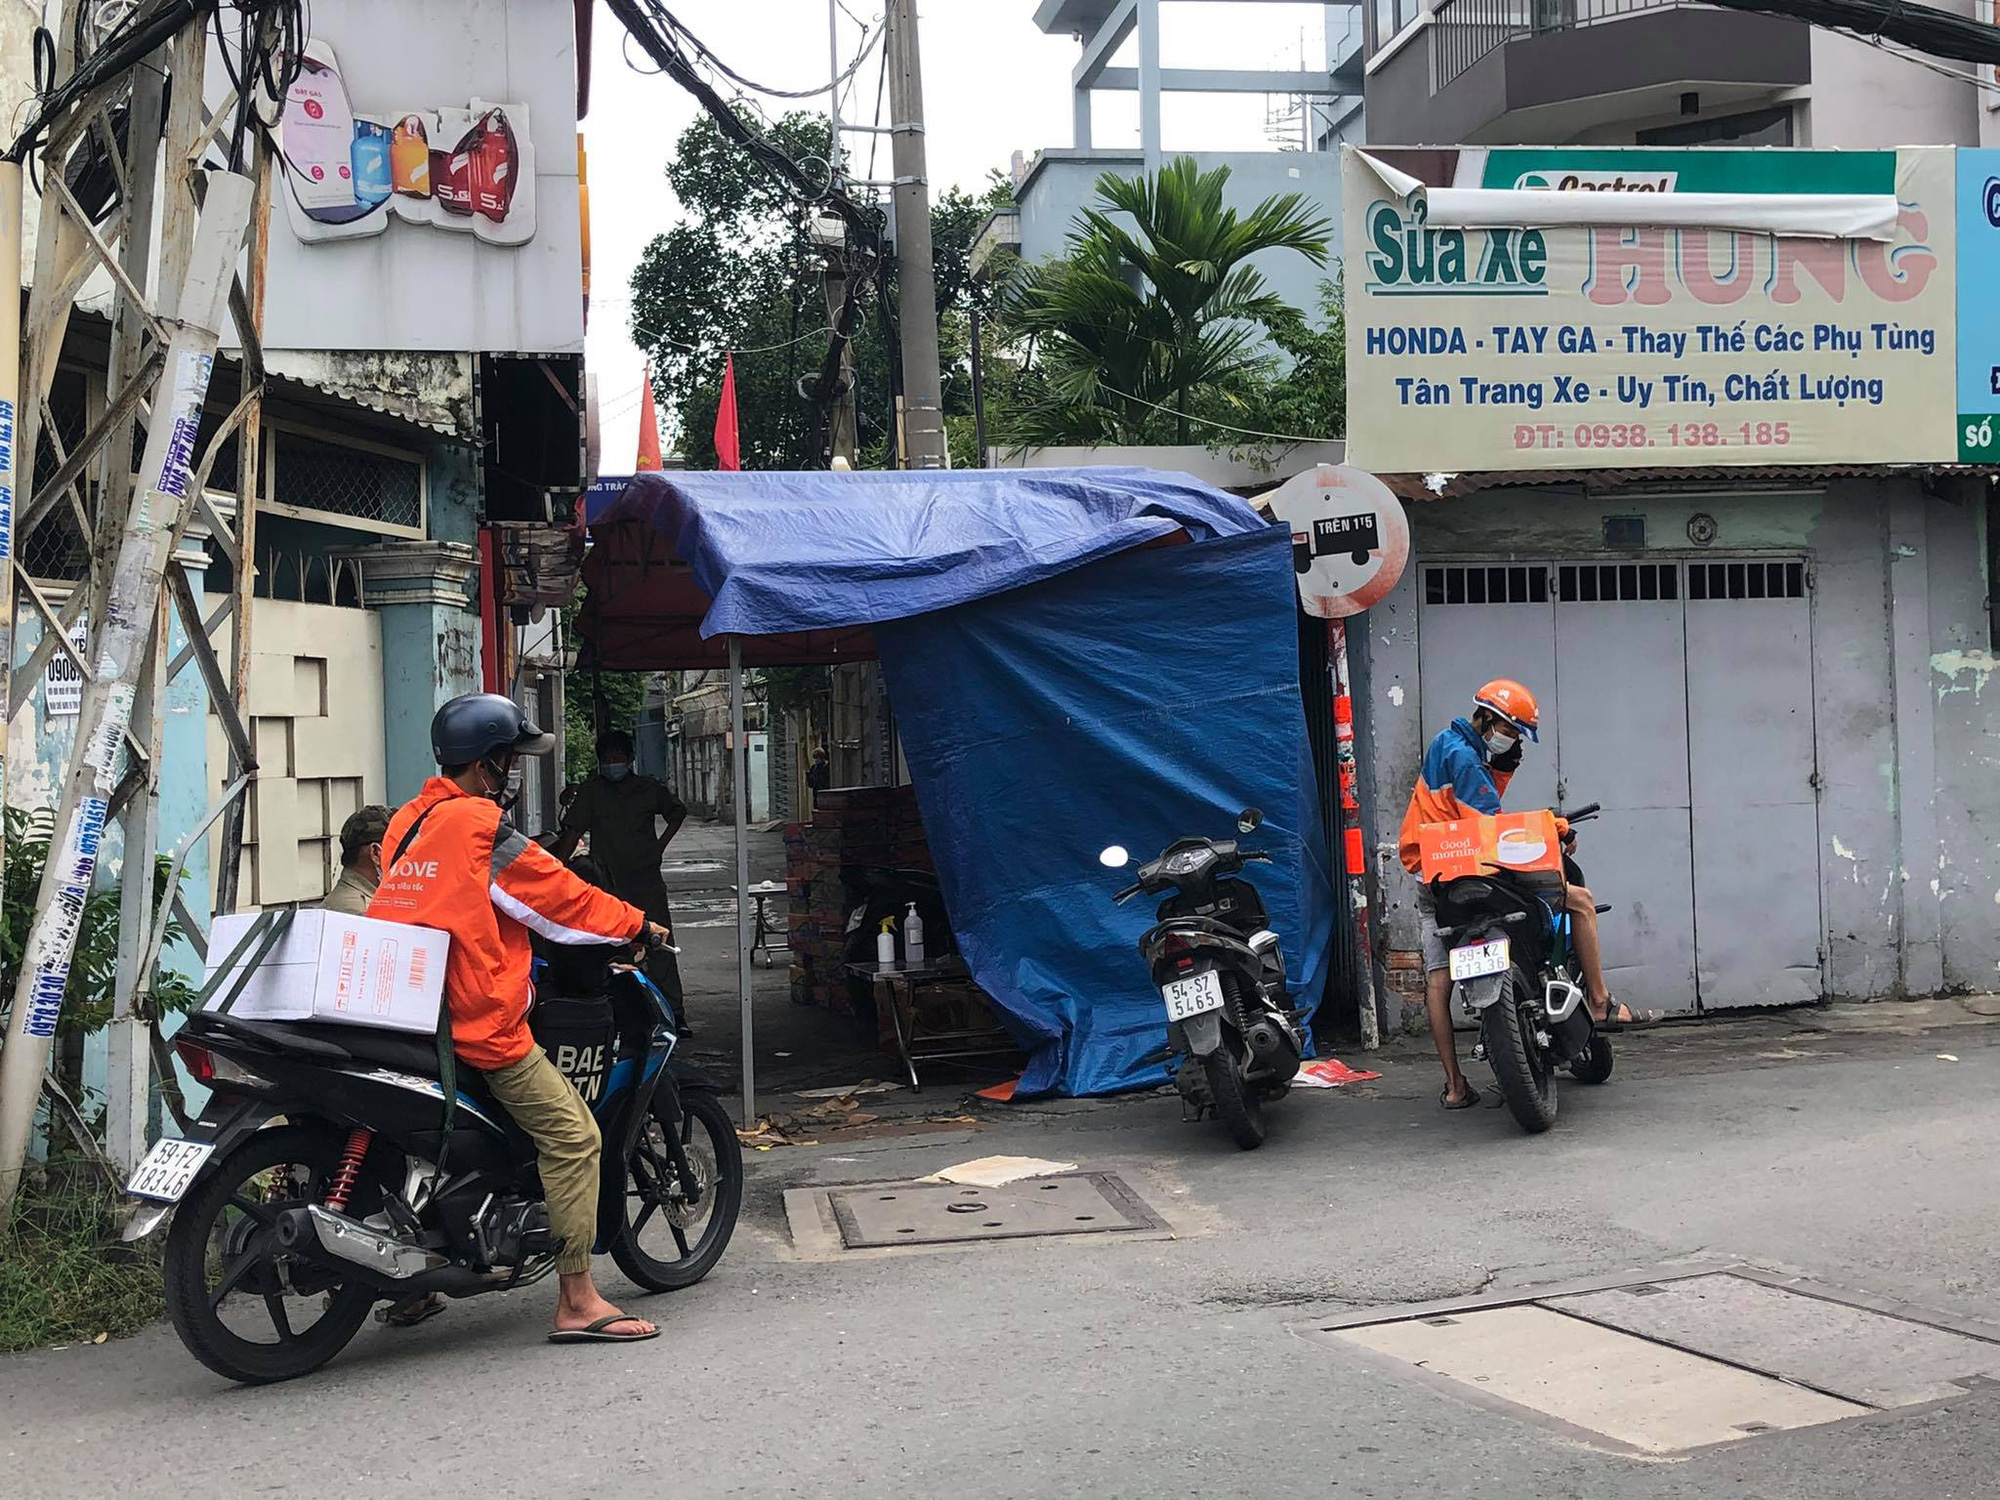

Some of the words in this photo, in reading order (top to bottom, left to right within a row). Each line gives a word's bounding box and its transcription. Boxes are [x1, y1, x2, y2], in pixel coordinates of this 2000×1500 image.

[1366, 326, 1467, 355] HONDA
[1492, 326, 1549, 354] TAY
[1557, 326, 1597, 354] GA
[1622, 324, 1687, 358] Thay
[1696, 320, 1746, 352] Thế
[1754, 324, 1804, 351] Các
[1813, 324, 1862, 358] Phụ
[1871, 322, 1935, 355] Tùng
[1395, 377, 1450, 405] Tân
[1459, 376, 1543, 409] Trang
[1552, 375, 1590, 404] Xe
[1616, 374, 1653, 408] Uy
[1663, 374, 1716, 407] Tín,
[1724, 368, 1790, 402] Chất
[1800, 373, 1883, 408] Lượng
[1514, 424, 1564, 449] ĐT:
[1574, 423, 1656, 448] 0938.
[1667, 422, 1728, 447] 138.
[1740, 421, 1791, 446] 185
[1965, 416, 1993, 448] SỐ
[1318, 517, 1350, 535] TRÊN
[1440, 837, 1471, 850] Good
[1175, 992, 1215, 1016] 5465
[556, 1045, 605, 1073] BAE
[572, 1074, 601, 1101] TN
[132, 1167, 189, 1196] 183.46
